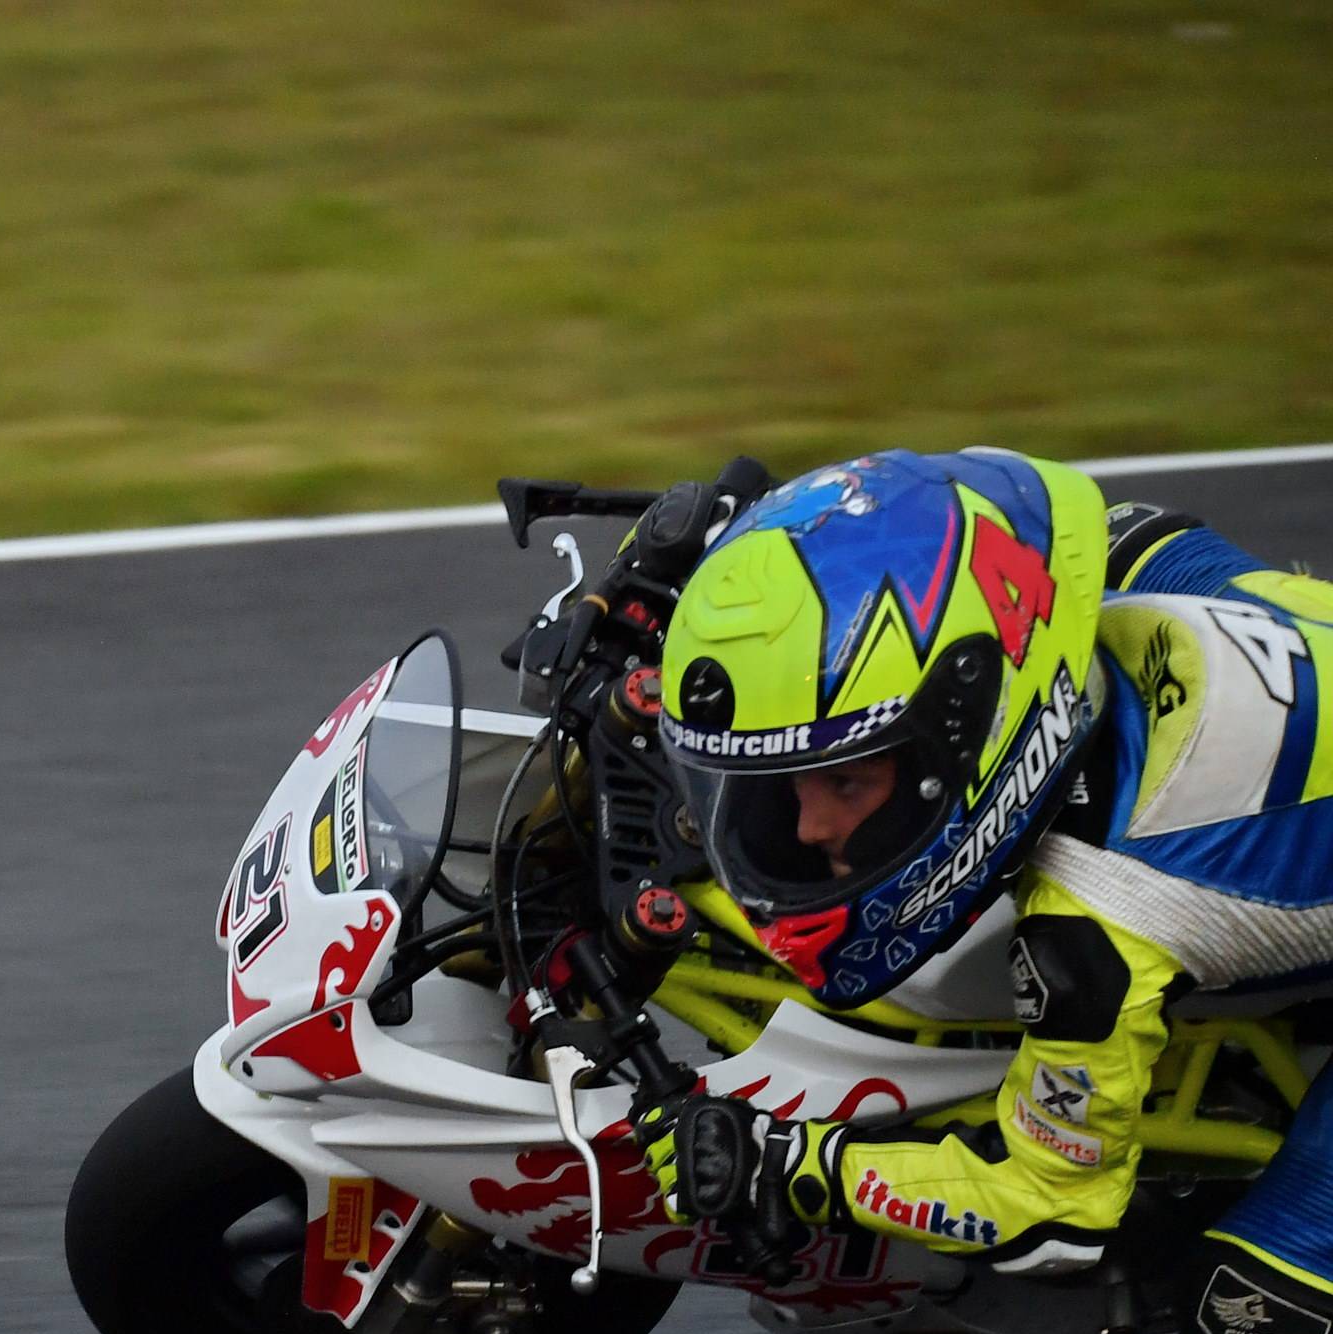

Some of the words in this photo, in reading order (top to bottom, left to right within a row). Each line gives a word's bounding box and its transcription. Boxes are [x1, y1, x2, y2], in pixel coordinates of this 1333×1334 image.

[970, 514, 1057, 671] 4
[1206, 605, 1311, 705] 4
[898, 681, 1075, 925] SCORPION
[233, 814, 291, 970] 21
[855, 1168, 998, 1246] italkit
